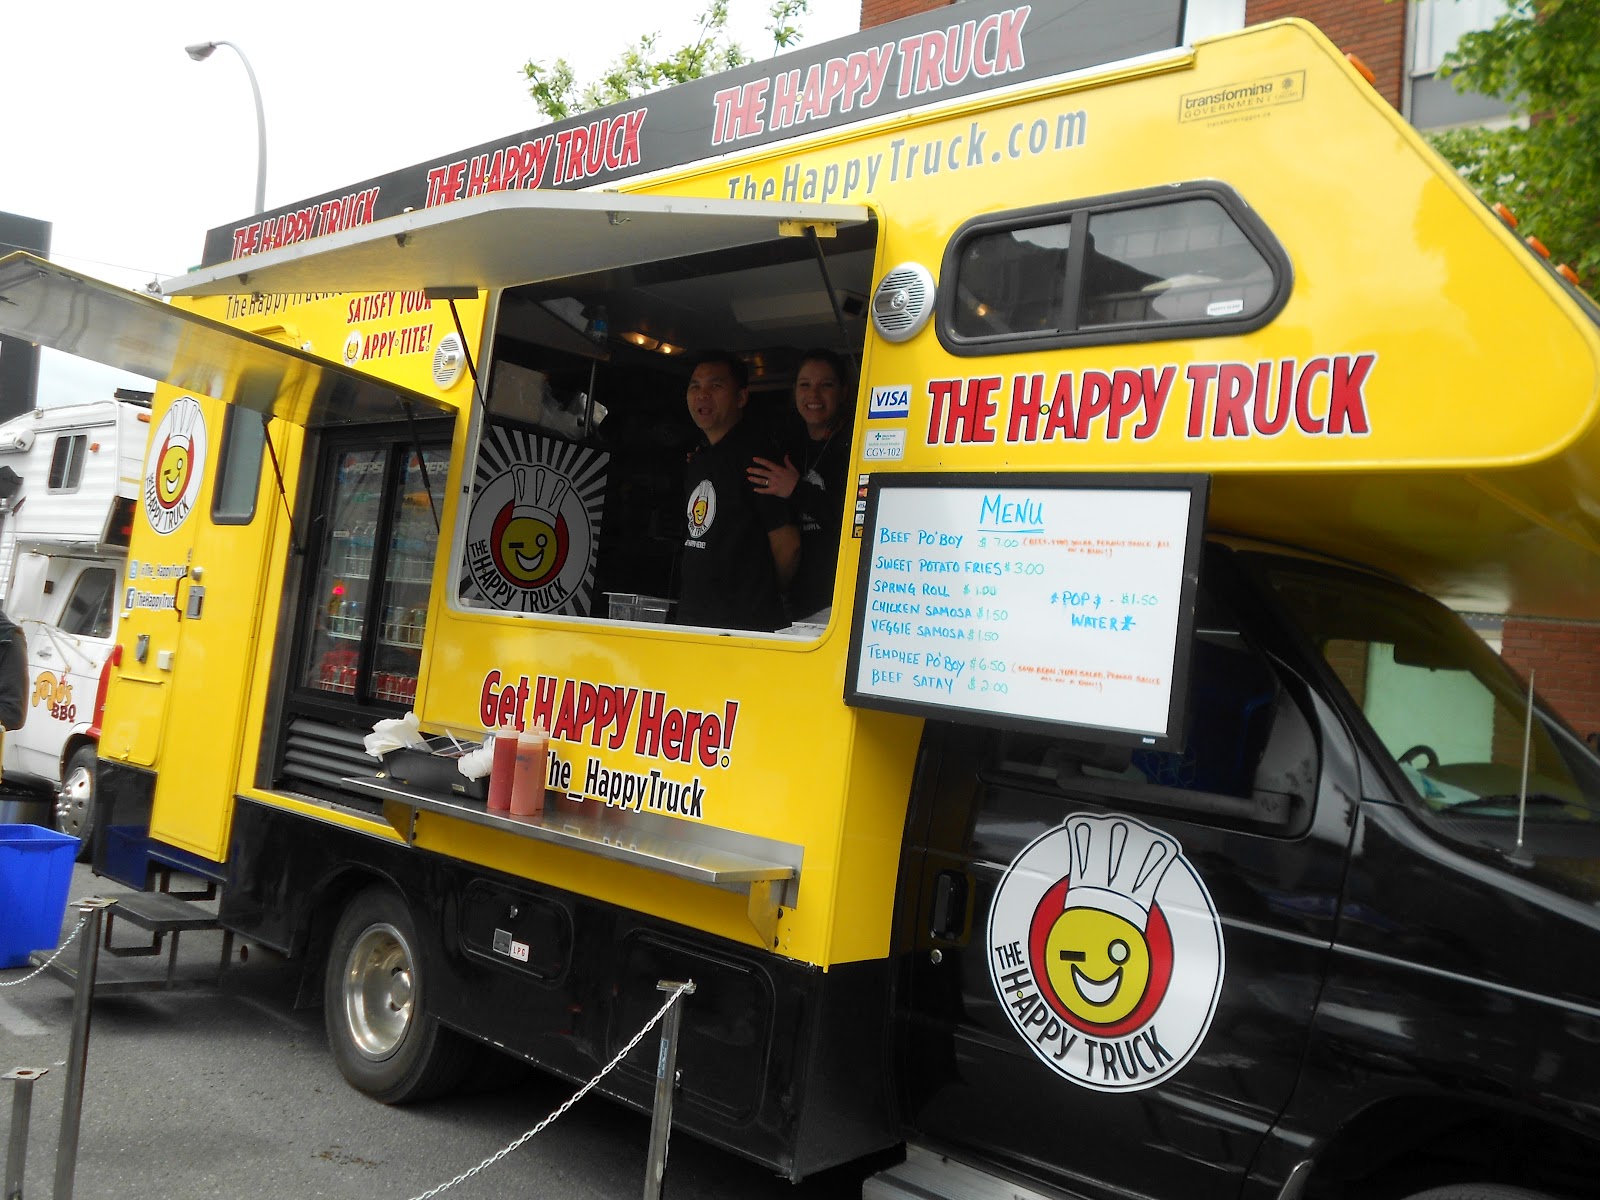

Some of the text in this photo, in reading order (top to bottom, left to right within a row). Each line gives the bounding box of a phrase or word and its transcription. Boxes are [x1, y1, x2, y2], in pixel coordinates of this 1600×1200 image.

[712, 5, 1032, 145] THE HAPPY TRUCK
[1184, 97, 1271, 118] GOVERNMENT
[1185, 82, 1273, 109] transforming
[425, 160, 467, 209] THE
[553, 108, 648, 185] TRUCK
[232, 222, 261, 260] THE
[318, 187, 380, 236] TRUCK
[347, 292, 396, 324] SATISFY
[876, 390, 908, 407] VISA
[926, 354, 1376, 445] THE HAPPY TRUCK
[866, 446, 901, 458] CGY-102
[164, 495, 189, 530] TRUCK
[469, 539, 488, 558] THE
[521, 578, 569, 612] TRUCK
[875, 556, 912, 572] SWEET
[919, 559, 960, 573] POTATO
[964, 561, 1002, 575] FRIES
[137, 592, 175, 609] TheHappyTruc
[873, 580, 916, 596] SPRING
[922, 583, 951, 597] ROLL
[1063, 591, 1090, 606] POP
[872, 600, 920, 614] CHICKEN
[925, 605, 972, 618] SAMOSA
[871, 620, 911, 636] VEGGIE
[917, 625, 965, 639] SAMOSA
[1072, 613, 1118, 631] WATER
[872, 669, 903, 685] BEEF
[913, 675, 953, 694] SATAY
[51, 702, 76, 723] BBQ
[480, 670, 739, 768] Get HAPPY Here!
[547, 751, 704, 818] he_HappyTruck
[995, 941, 1174, 1081] THE HAPPY TRUCK
